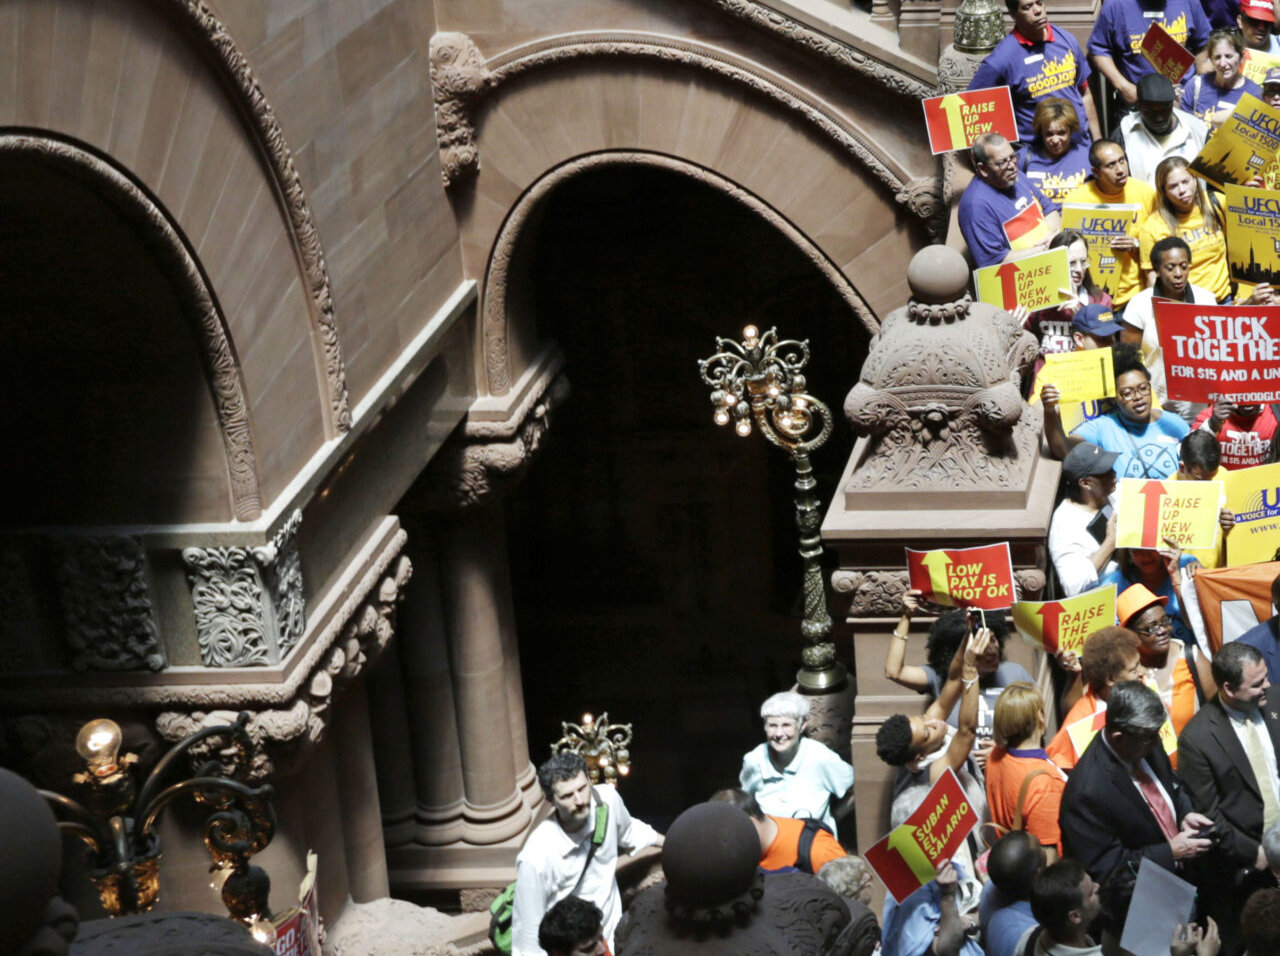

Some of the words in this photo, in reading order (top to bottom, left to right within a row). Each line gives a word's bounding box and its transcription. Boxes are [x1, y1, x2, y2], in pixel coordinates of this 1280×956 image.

[963, 101, 996, 116] RAISE
[1082, 217, 1128, 234] UFCW
[1239, 215, 1267, 227] Local
[1018, 265, 1052, 282] RAISE
[1019, 286, 1047, 301] NEW
[1193, 316, 1271, 343] STICK
[1171, 364, 1195, 379] FOR
[1197, 367, 1218, 380] $15
[1220, 368, 1248, 382] AND
[1251, 369, 1262, 381] A
[1162, 497, 1202, 510] RAISE
[1160, 521, 1192, 533] NEW
[949, 562, 983, 577] LOW
[951, 587, 983, 601] NOT
[986, 584, 1010, 598] OK
[1061, 604, 1106, 626] RAISE
[916, 793, 950, 842] SUBAN
[928, 801, 969, 860] SALARIO
